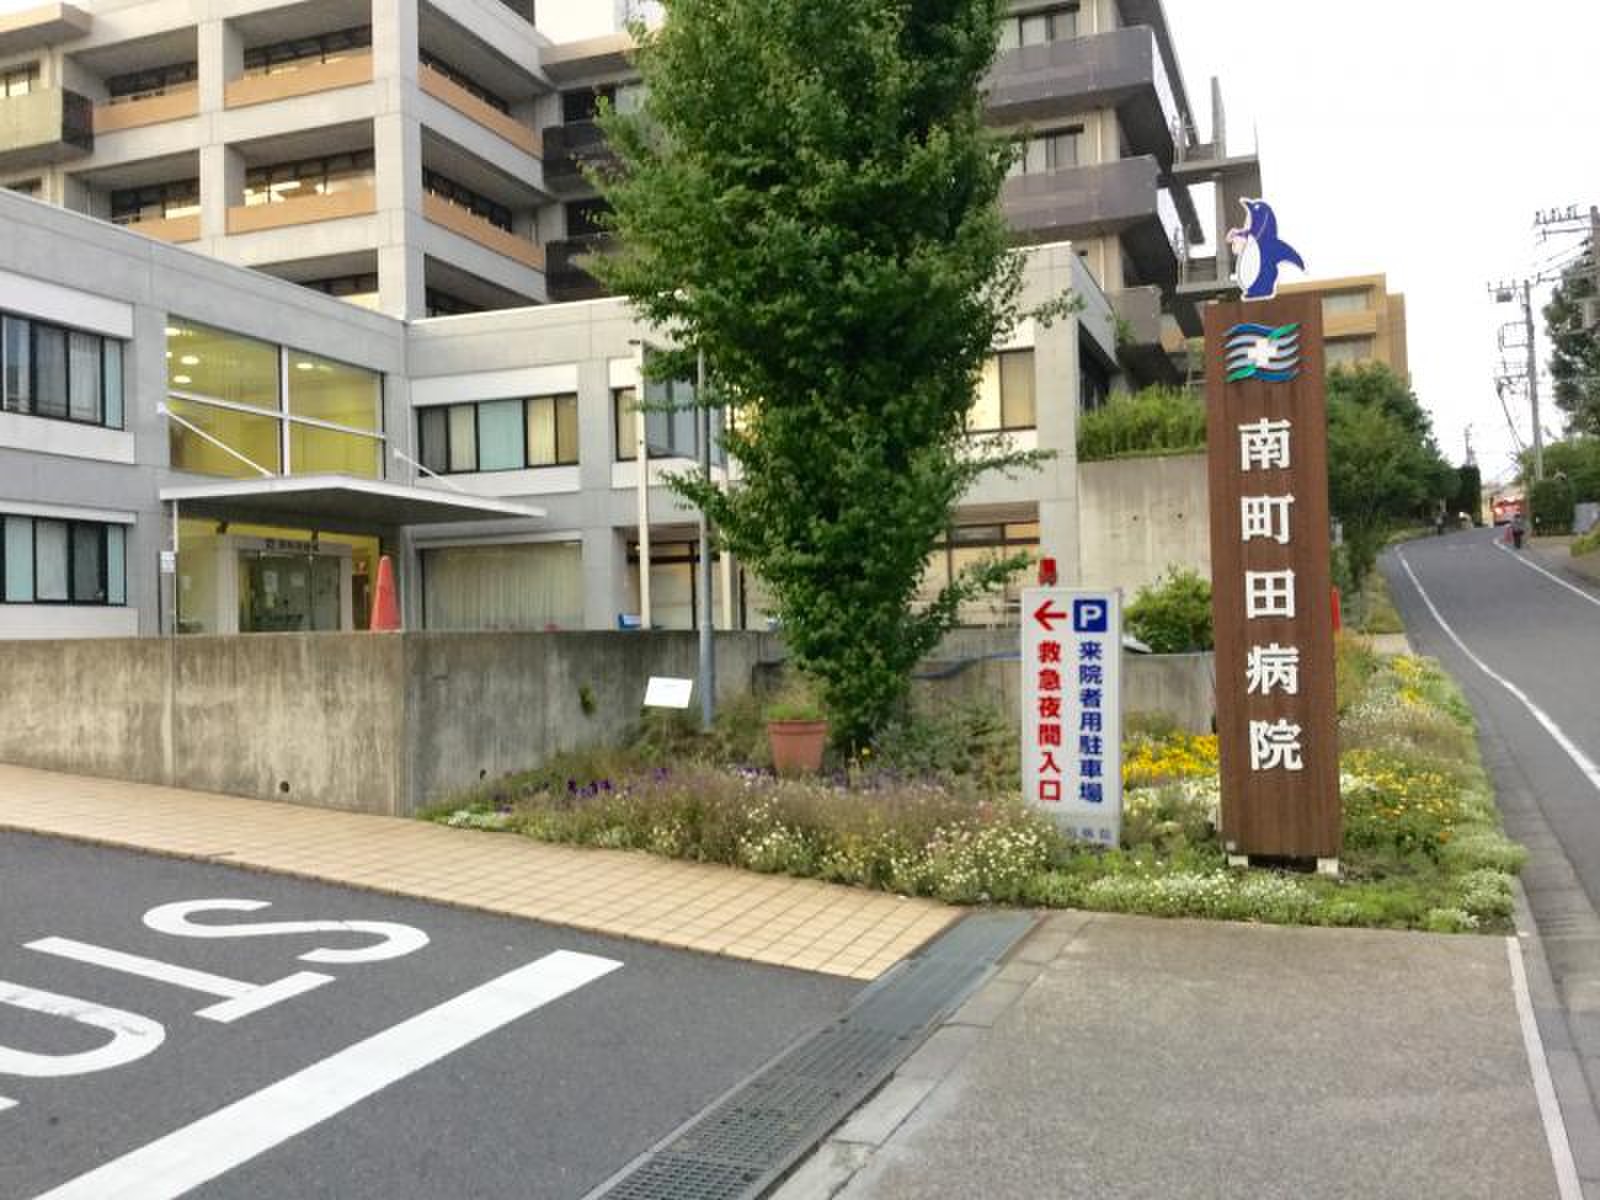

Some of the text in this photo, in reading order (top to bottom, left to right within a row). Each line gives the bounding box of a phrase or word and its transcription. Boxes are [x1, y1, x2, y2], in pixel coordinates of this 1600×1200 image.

[1080, 605, 1102, 628] P
[1238, 417, 1303, 770] 南町田病院
[1038, 641, 1061, 801] 救急夜間入口
[1079, 641, 1103, 802] 来院者用駐車場
